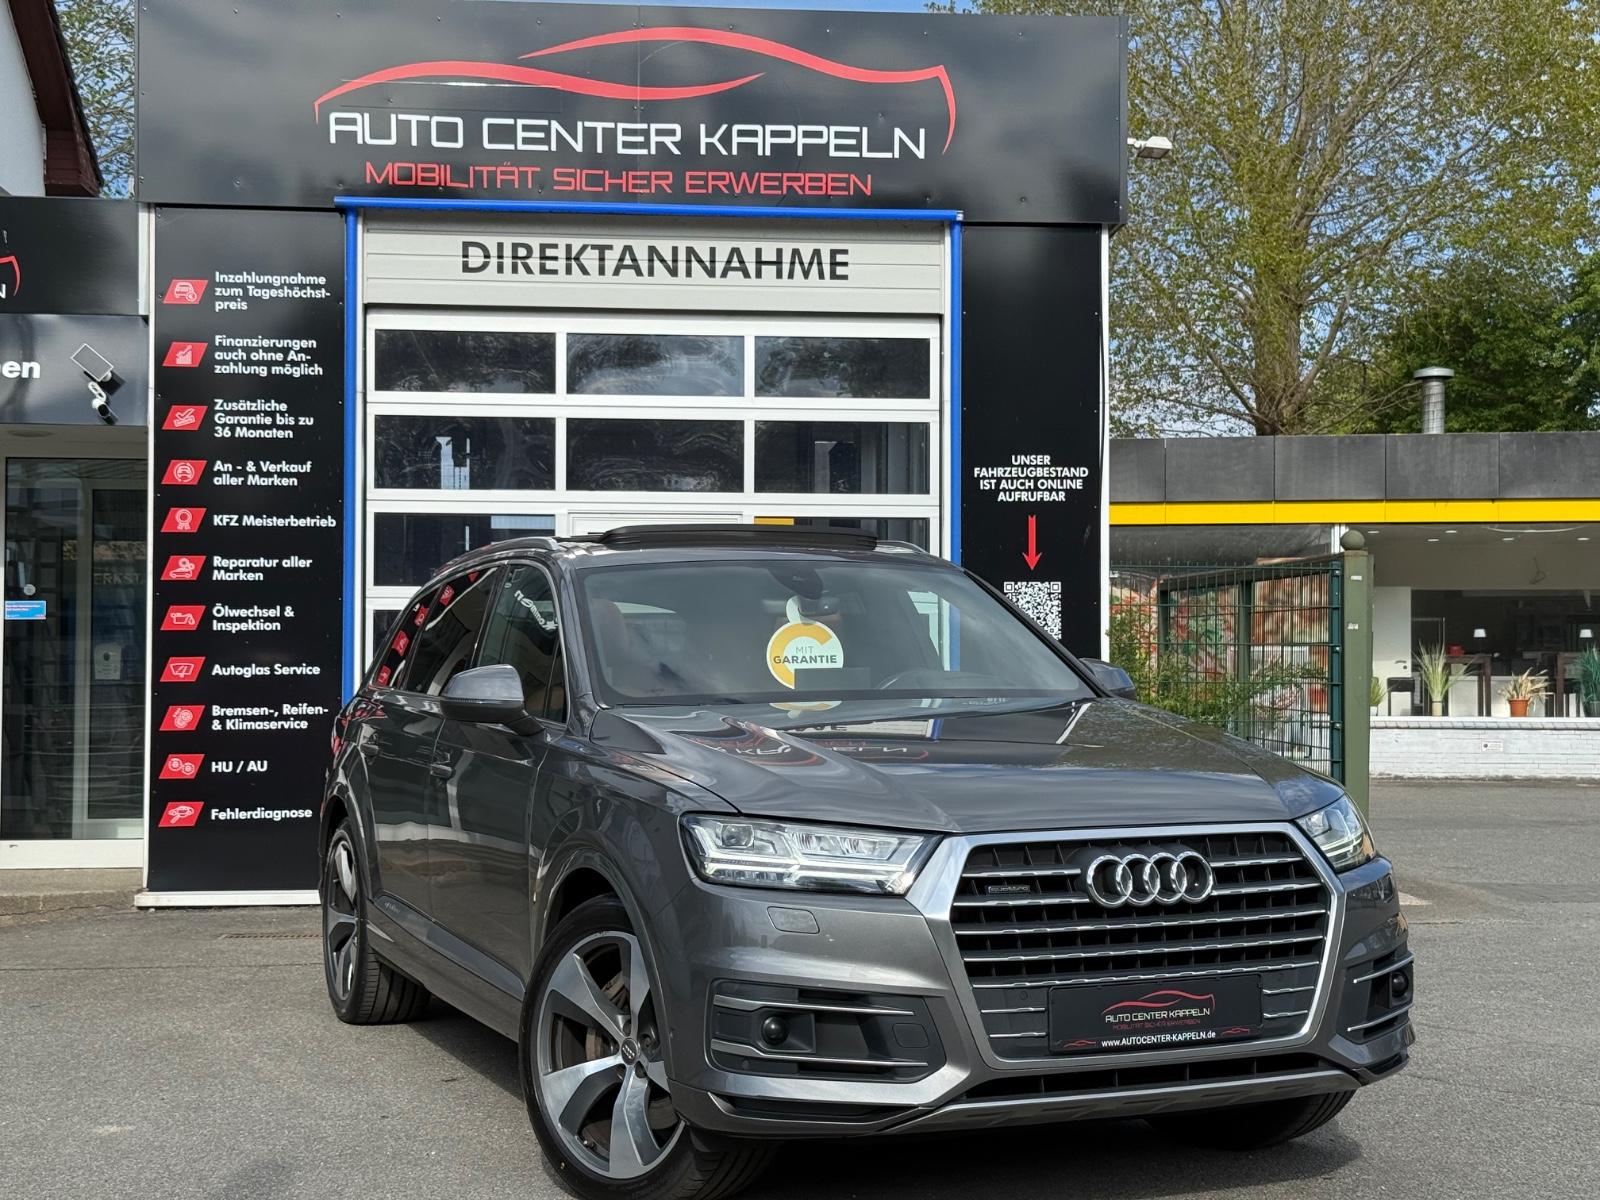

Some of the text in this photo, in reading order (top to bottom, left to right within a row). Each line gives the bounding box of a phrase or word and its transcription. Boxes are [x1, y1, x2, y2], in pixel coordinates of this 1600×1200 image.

[329, 112, 925, 159] AUTO CENTER KAPPELN
[366, 161, 872, 196] MOBILITÄT SICHER ERWERBEN
[462, 242, 848, 280] DIREKTANNAHME
[215, 272, 326, 286] Inzahlungnahme
[215, 285, 331, 299] zum Tageshöchst-
[215, 299, 247, 312] preis
[215, 335, 317, 349] Finanzierungen
[215, 349, 311, 361] auch ohne An-
[0, 361, 41, 379] en
[215, 363, 322, 377] zahlung möglich
[215, 399, 287, 411] Zusätzliche
[215, 413, 313, 425] Garantie bis zu
[215, 426, 293, 438] 36 Monaten
[214, 461, 232, 471] An
[246, 461, 256, 471] &
[260, 461, 312, 472] Verkauf
[1012, 455, 1050, 465] UNSER
[974, 467, 1088, 477] FAHRZEUGBESTAND
[214, 474, 297, 485] aller Marken
[980, 479, 1082, 489] IST AUCH ONLINE
[998, 491, 1065, 501] AUFRUFBAR
[214, 515, 336, 527] KFZ Meisterbetrieb
[214, 556, 312, 570] Reparatur aller
[213, 569, 263, 580] Marken
[213, 603, 294, 617] Ölwechsel &
[213, 619, 280, 633] Inspektion
[795, 646, 814, 654] MIT
[773, 655, 838, 664] GARANTIE
[212, 663, 320, 677] Autoglas Service
[213, 703, 328, 717] Bremsen-, Reifen-
[212, 718, 308, 730] & Klimaservice
[212, 761, 267, 773] HU / AU
[212, 808, 312, 821] Fehlerdiagnose
[1105, 1008, 1209, 1023] AUTO CENTER KAPPELN
[1101, 1030, 1216, 1047] www.AUTOCENTER-KAPPELN.de
